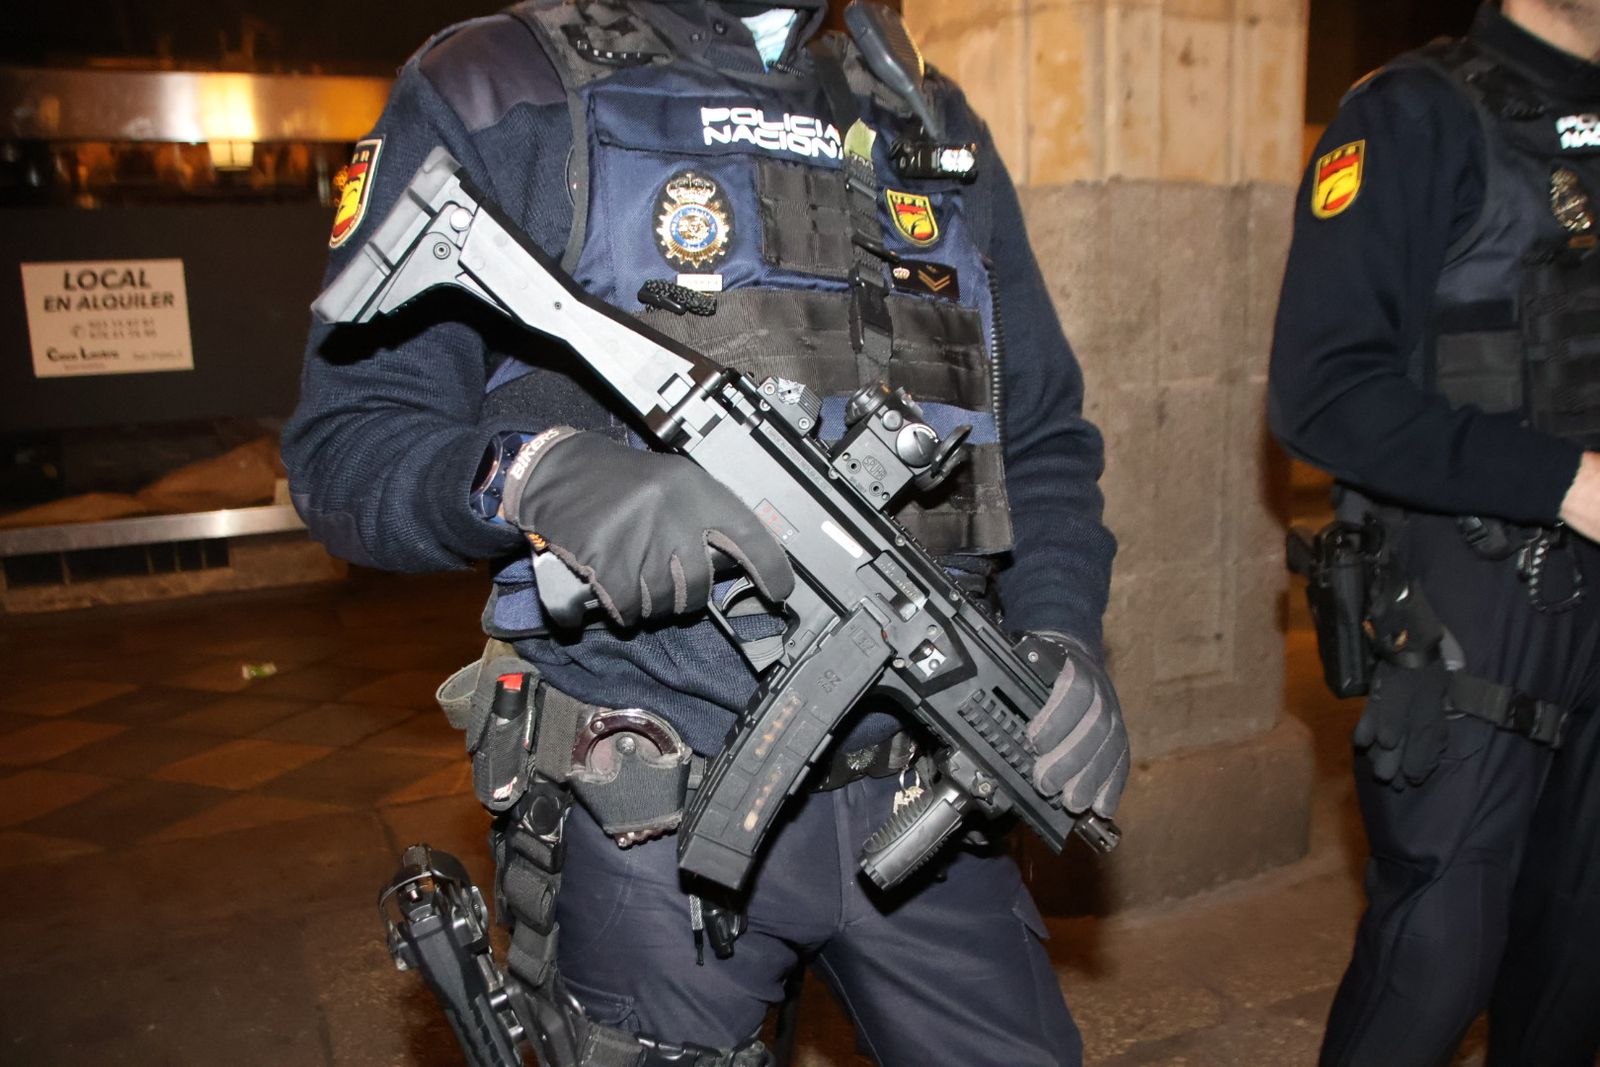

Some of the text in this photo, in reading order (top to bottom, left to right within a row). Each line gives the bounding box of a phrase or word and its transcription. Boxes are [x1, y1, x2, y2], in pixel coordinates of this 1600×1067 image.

[701, 107, 841, 147] POLICIA
[703, 125, 844, 160] NACION
[63, 268, 152, 291] LOCAL
[44, 292, 175, 312] EN ALQUILER
